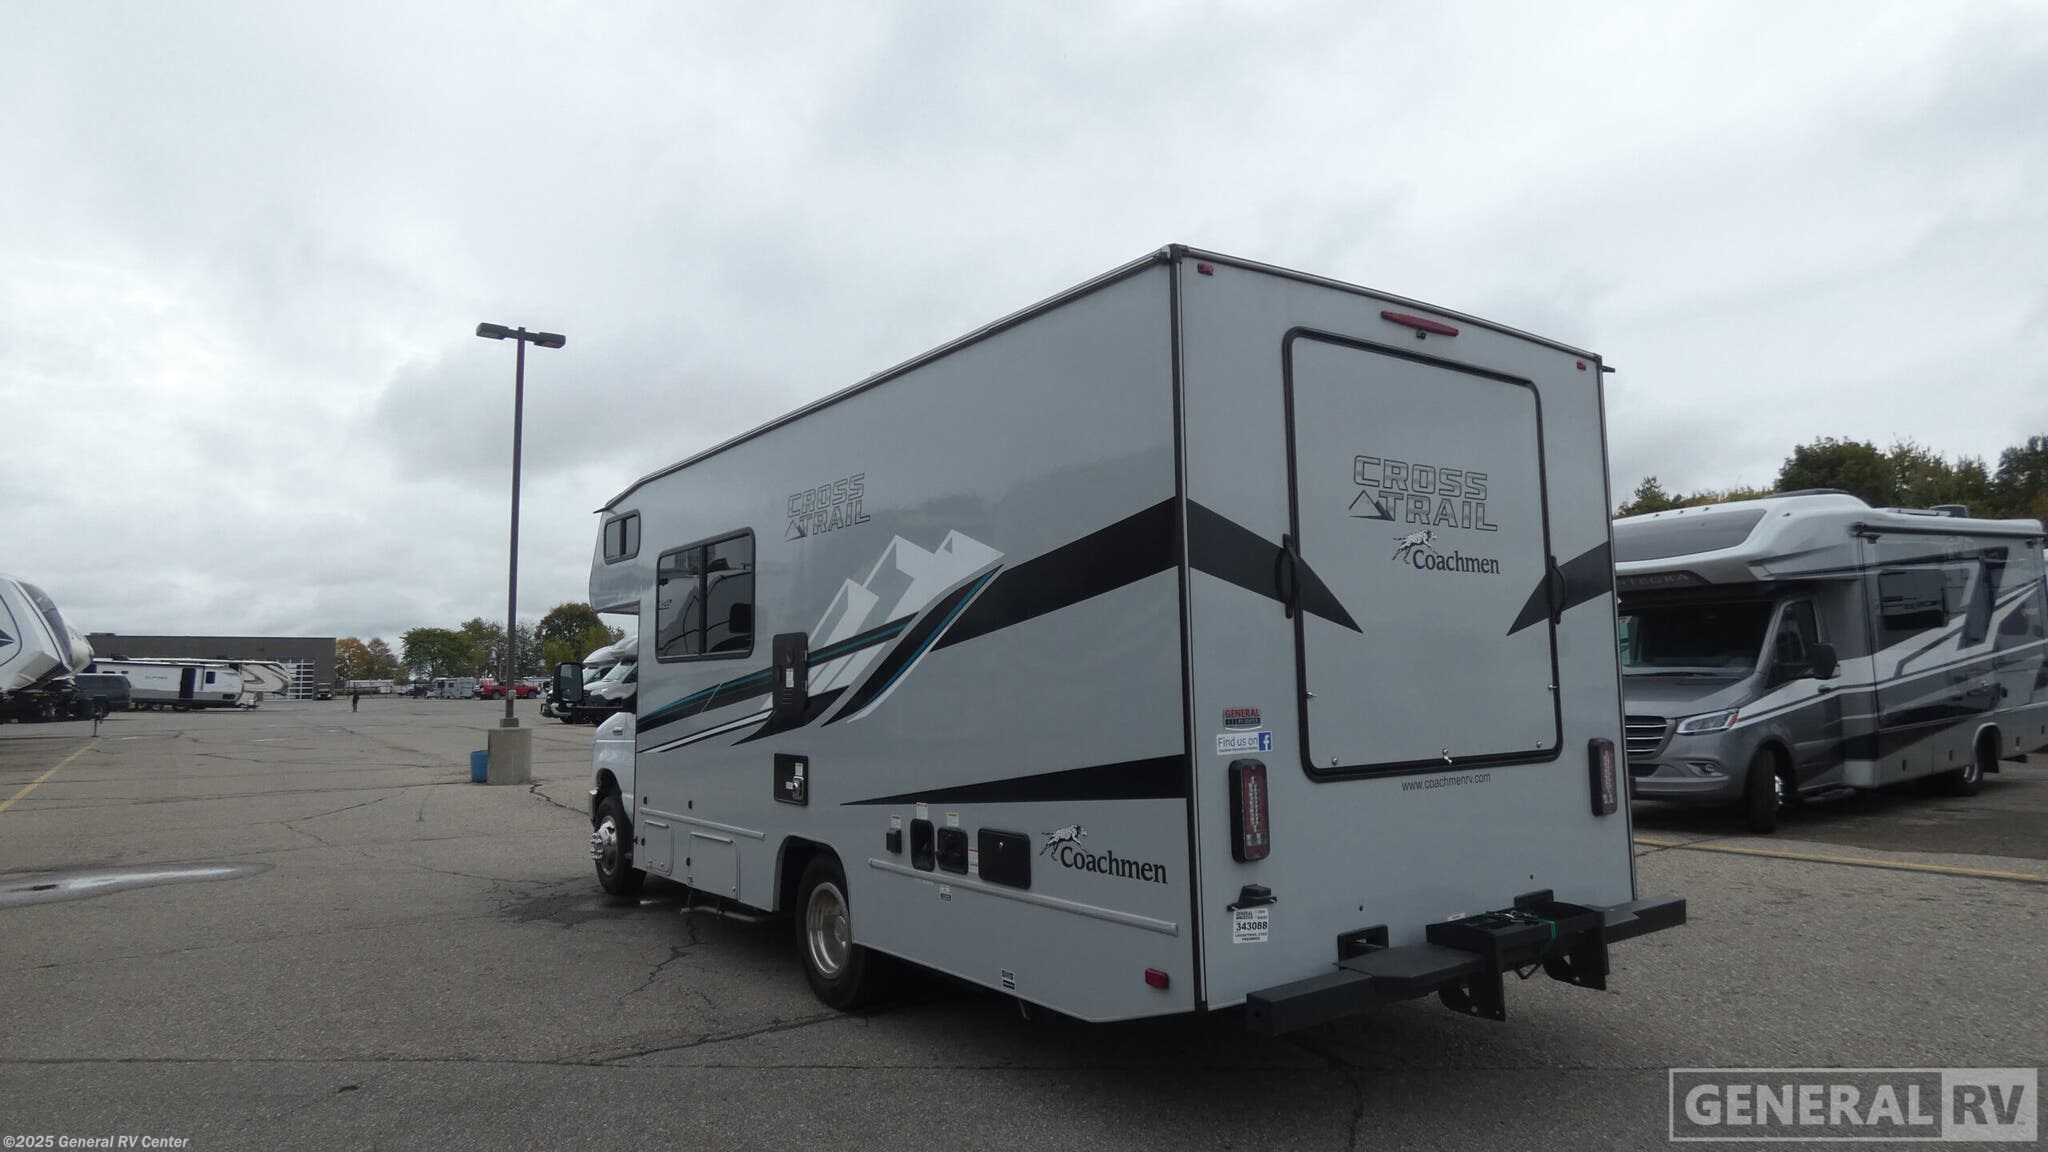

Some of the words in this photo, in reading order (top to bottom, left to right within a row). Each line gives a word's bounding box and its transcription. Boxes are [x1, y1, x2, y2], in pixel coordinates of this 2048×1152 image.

[787, 472, 865, 518] CROSS
[1353, 455, 1488, 501] CROSS
[799, 499, 871, 536] TRAIL
[1378, 490, 1498, 532] TRAIL
[1412, 549, 1501, 574] Coachmen
[1218, 736, 1236, 747] Find
[1401, 773, 1491, 791] www.coachmenrv.com
[1060, 846, 1168, 884] Coachmen
[1236, 921, 1268, 931] 343088
